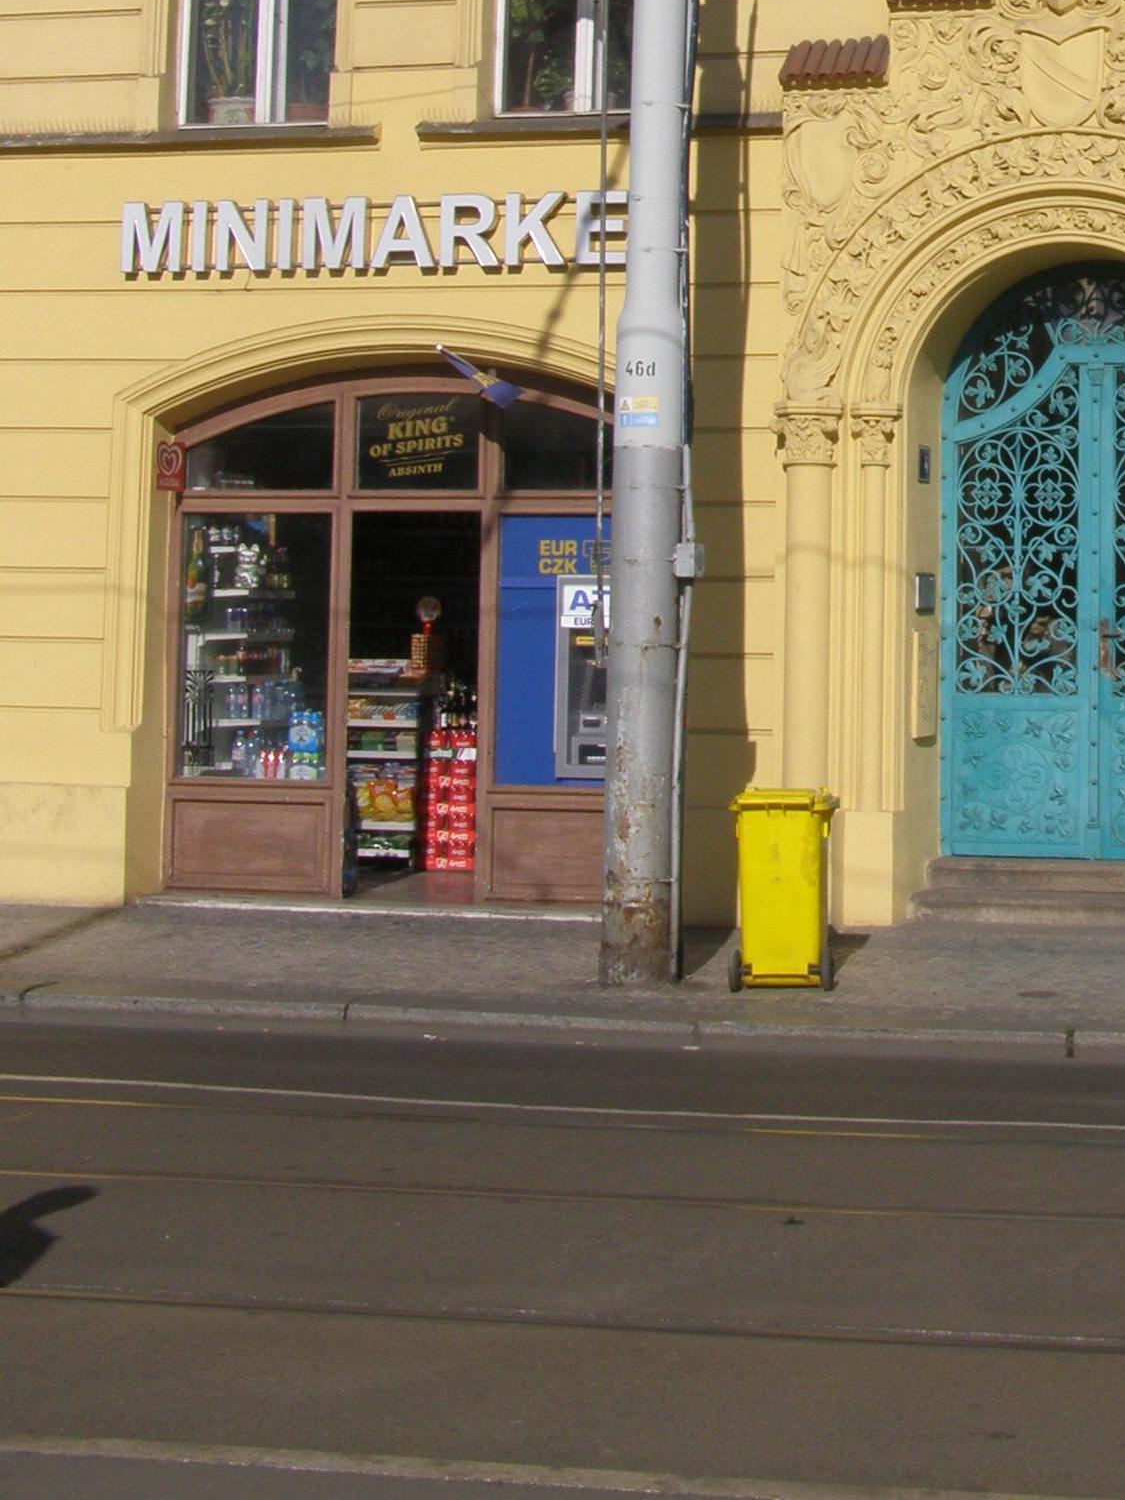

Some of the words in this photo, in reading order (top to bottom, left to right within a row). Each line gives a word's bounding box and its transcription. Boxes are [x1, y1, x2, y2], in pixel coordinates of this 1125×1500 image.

[120, 190, 627, 275] MINIMARKE
[625, 360, 656, 377] 46d
[387, 416, 449, 441] KING
[369, 442, 392, 458] OF
[395, 433, 464, 455] SPIRITS
[388, 462, 443, 478] ABSINTH
[539, 539, 578, 556] EUR
[538, 557, 577, 575] CZK
